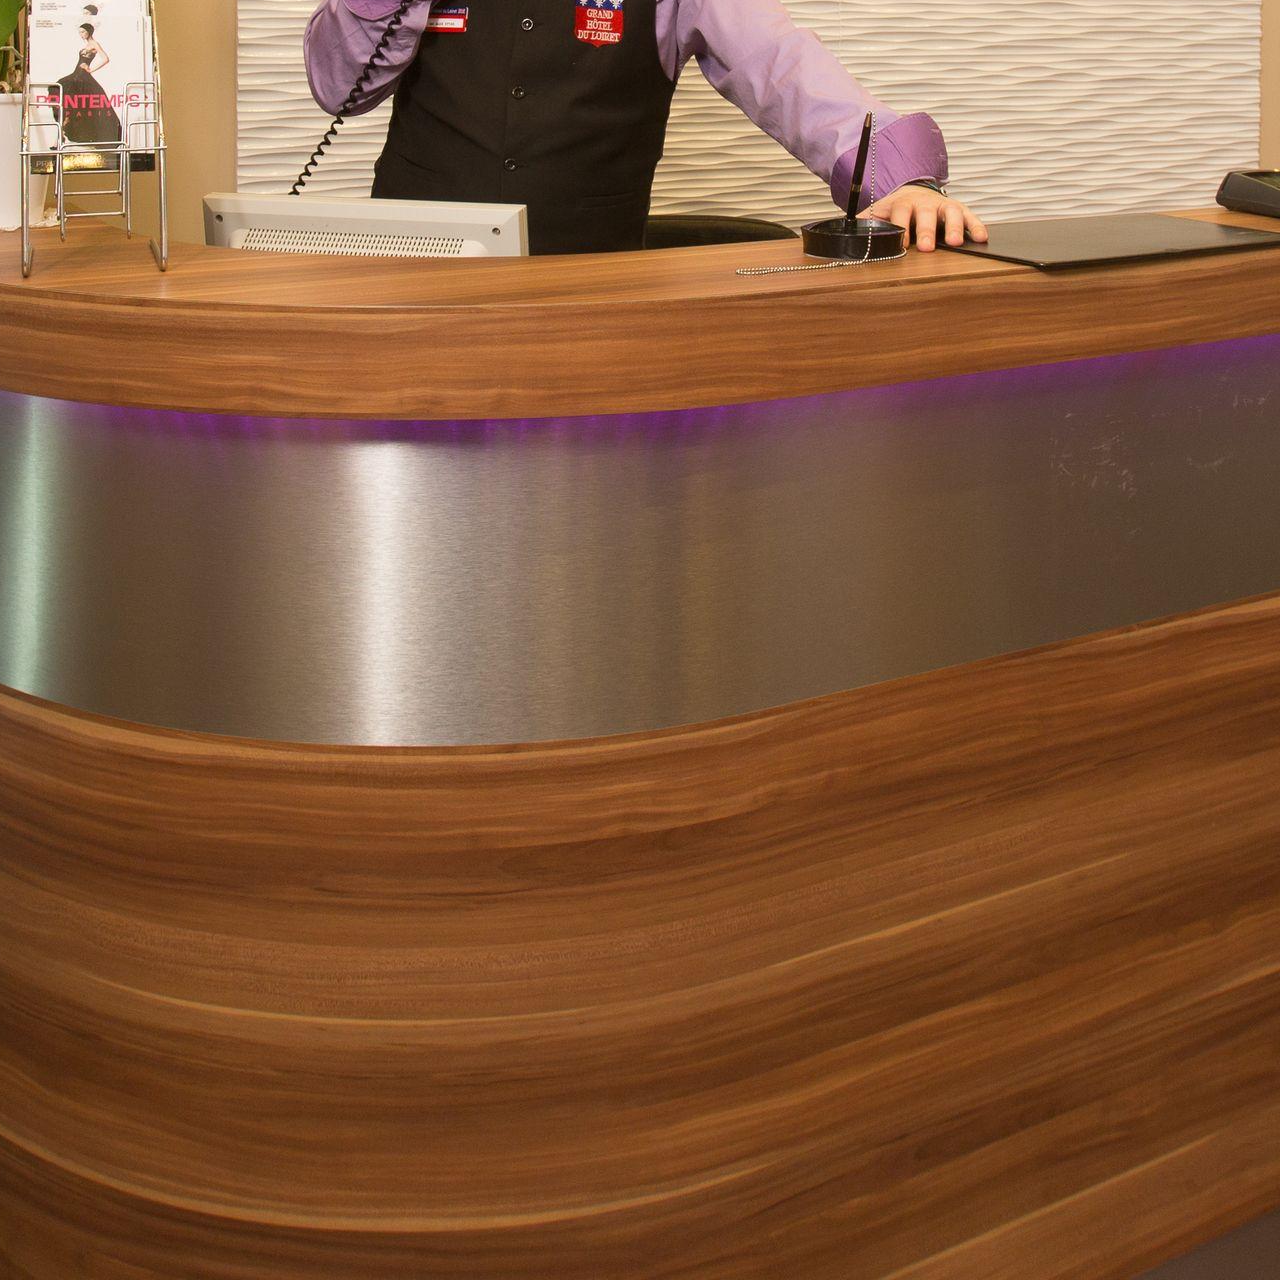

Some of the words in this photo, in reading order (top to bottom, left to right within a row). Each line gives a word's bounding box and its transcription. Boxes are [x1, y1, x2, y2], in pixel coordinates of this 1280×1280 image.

[586, 9, 614, 20] GRAND
[586, 19, 613, 31] HÔTEL
[577, 29, 590, 39] DU
[592, 31, 621, 42] LOIRET
